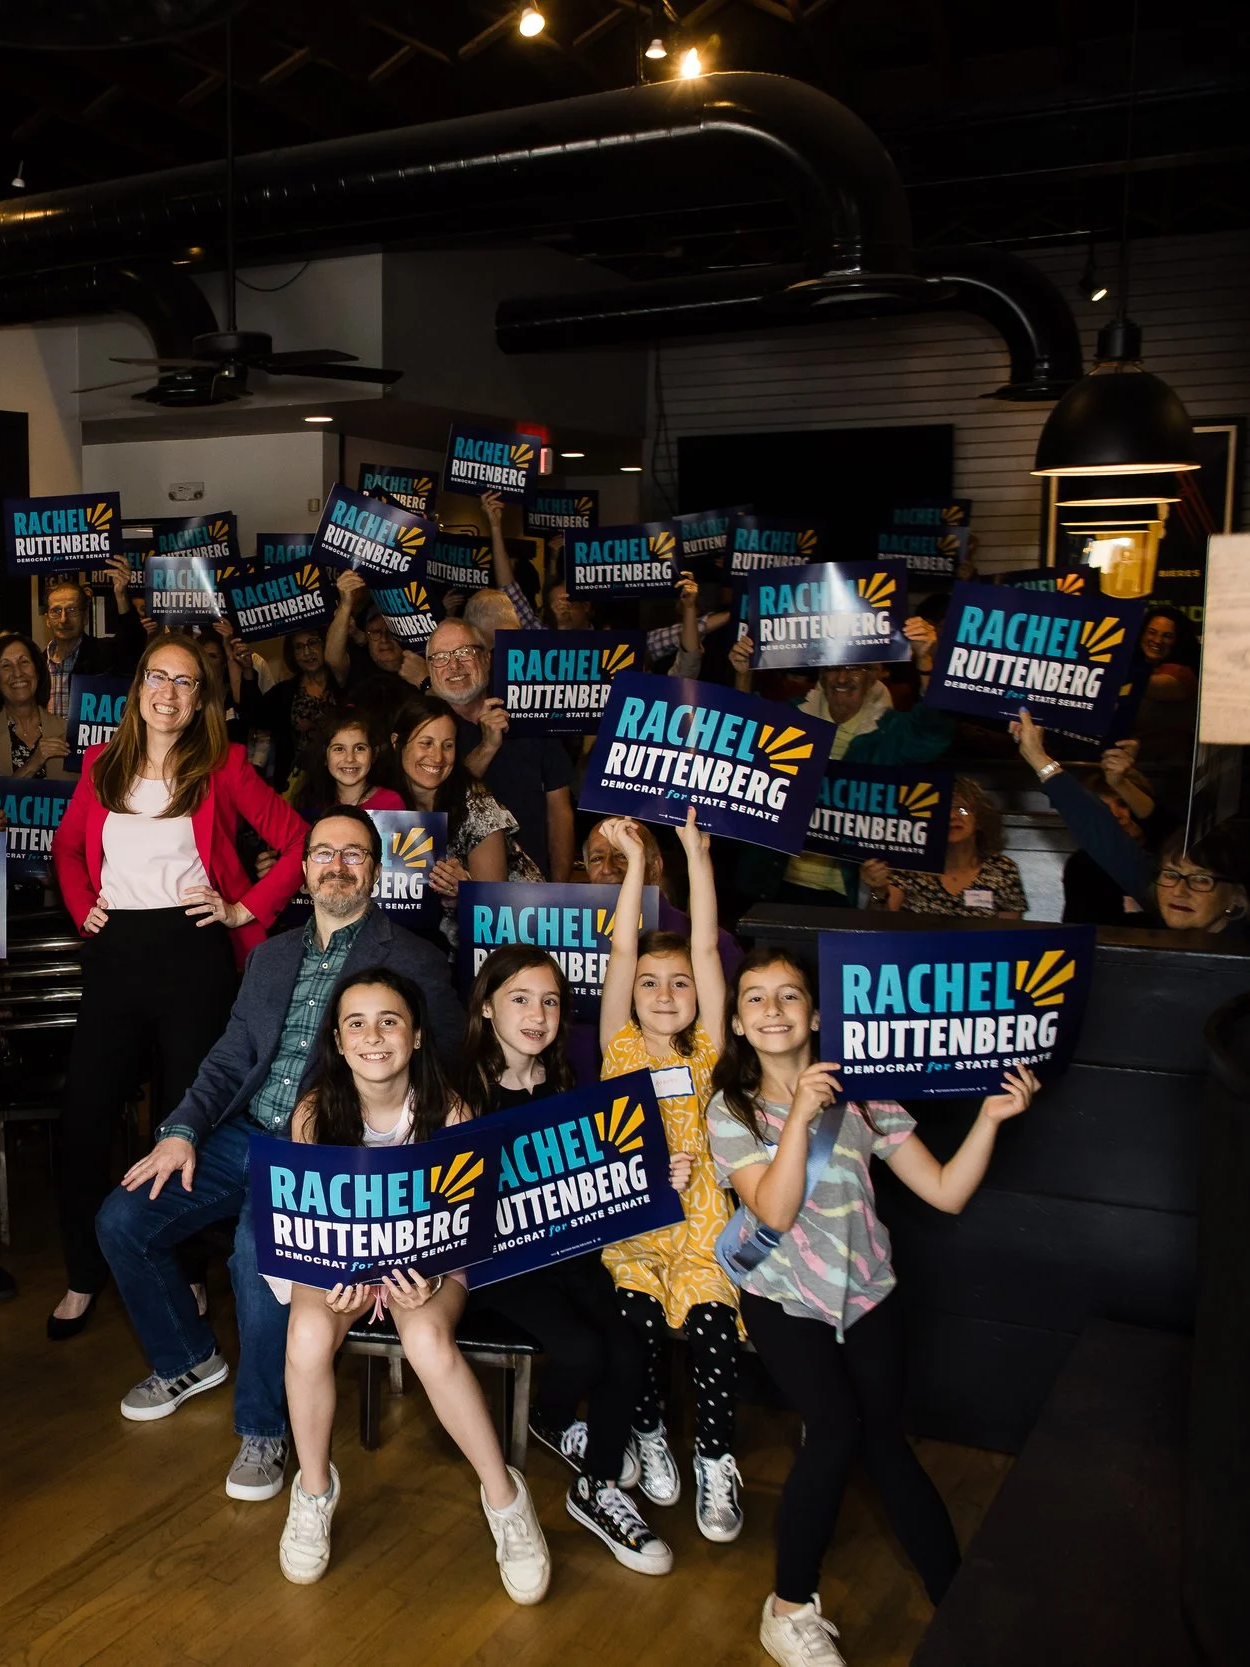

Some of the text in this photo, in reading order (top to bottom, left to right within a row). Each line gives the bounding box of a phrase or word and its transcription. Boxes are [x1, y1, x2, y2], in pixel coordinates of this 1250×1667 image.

[454, 436, 511, 466] RACHEL
[451, 460, 526, 487] RUTTENBERG
[451, 477, 477, 486] DEMOCRAT
[503, 486, 524, 494] SENATE
[13, 508, 88, 536] RACHEL
[330, 500, 398, 548] RACHEL
[528, 513, 590, 528] RUTTENBERG
[15, 532, 110, 556] RUTTENBERG
[159, 526, 211, 553] RACHEL
[324, 524, 412, 573] RUTTENBERG
[574, 537, 650, 564] RACHEL
[734, 527, 798, 552] RACHEL
[321, 543, 382, 573] DEMOCRAT STATE
[426, 560, 489, 584] RUTTENBERG
[575, 561, 672, 584] RUTTENBERG
[231, 574, 301, 609] RACHEL
[237, 590, 324, 627] RUTTENBERG
[242, 623, 273, 633] DEMOCRAT
[285, 615, 303, 623] STATE
[303, 608, 326, 618] SENATE
[760, 642, 807, 651] DEMOCRAT
[956, 605, 1082, 660] RACHEL
[507, 650, 602, 681] RACHEL
[947, 647, 1105, 698] RUTTENBERG
[507, 685, 611, 710] RUTTENBER
[944, 679, 1006, 696] DEMOCRAT
[1027, 694, 1056, 705] STATE
[1058, 699, 1094, 711] SENATE
[551, 710, 591, 719] for STATE
[615, 696, 759, 763] RACHEL
[604, 741, 791, 811] RUTTENBERG
[601, 778, 665, 796] DEMOCRAT
[665, 789, 689, 801] for
[690, 794, 727, 811] STATE
[730, 804, 780, 823] SENATE
[816, 776, 898, 815] ACHEL
[809, 807, 928, 845] UTTENBERG
[858, 841, 886, 850] STATE
[888, 844, 925, 854] SENATE
[385, 902, 422, 910] SENATE
[474, 905, 597, 948] RACHEL
[842, 961, 1015, 1015] RACHEL
[843, 1011, 1059, 1060] RUTTENBERG
[844, 1052, 1053, 1075] DEMOCRAT for STATE SENATE
[498, 1116, 605, 1192] ACHEL
[269, 1165, 430, 1218] RACHEL
[494, 1154, 648, 1238] UTTENBERG
[272, 1203, 470, 1257] RUTTENBERG
[549, 1194, 651, 1237] for STATE SENATE
[275, 1238, 468, 1273] DEMOCRAT for STATE SENATE
